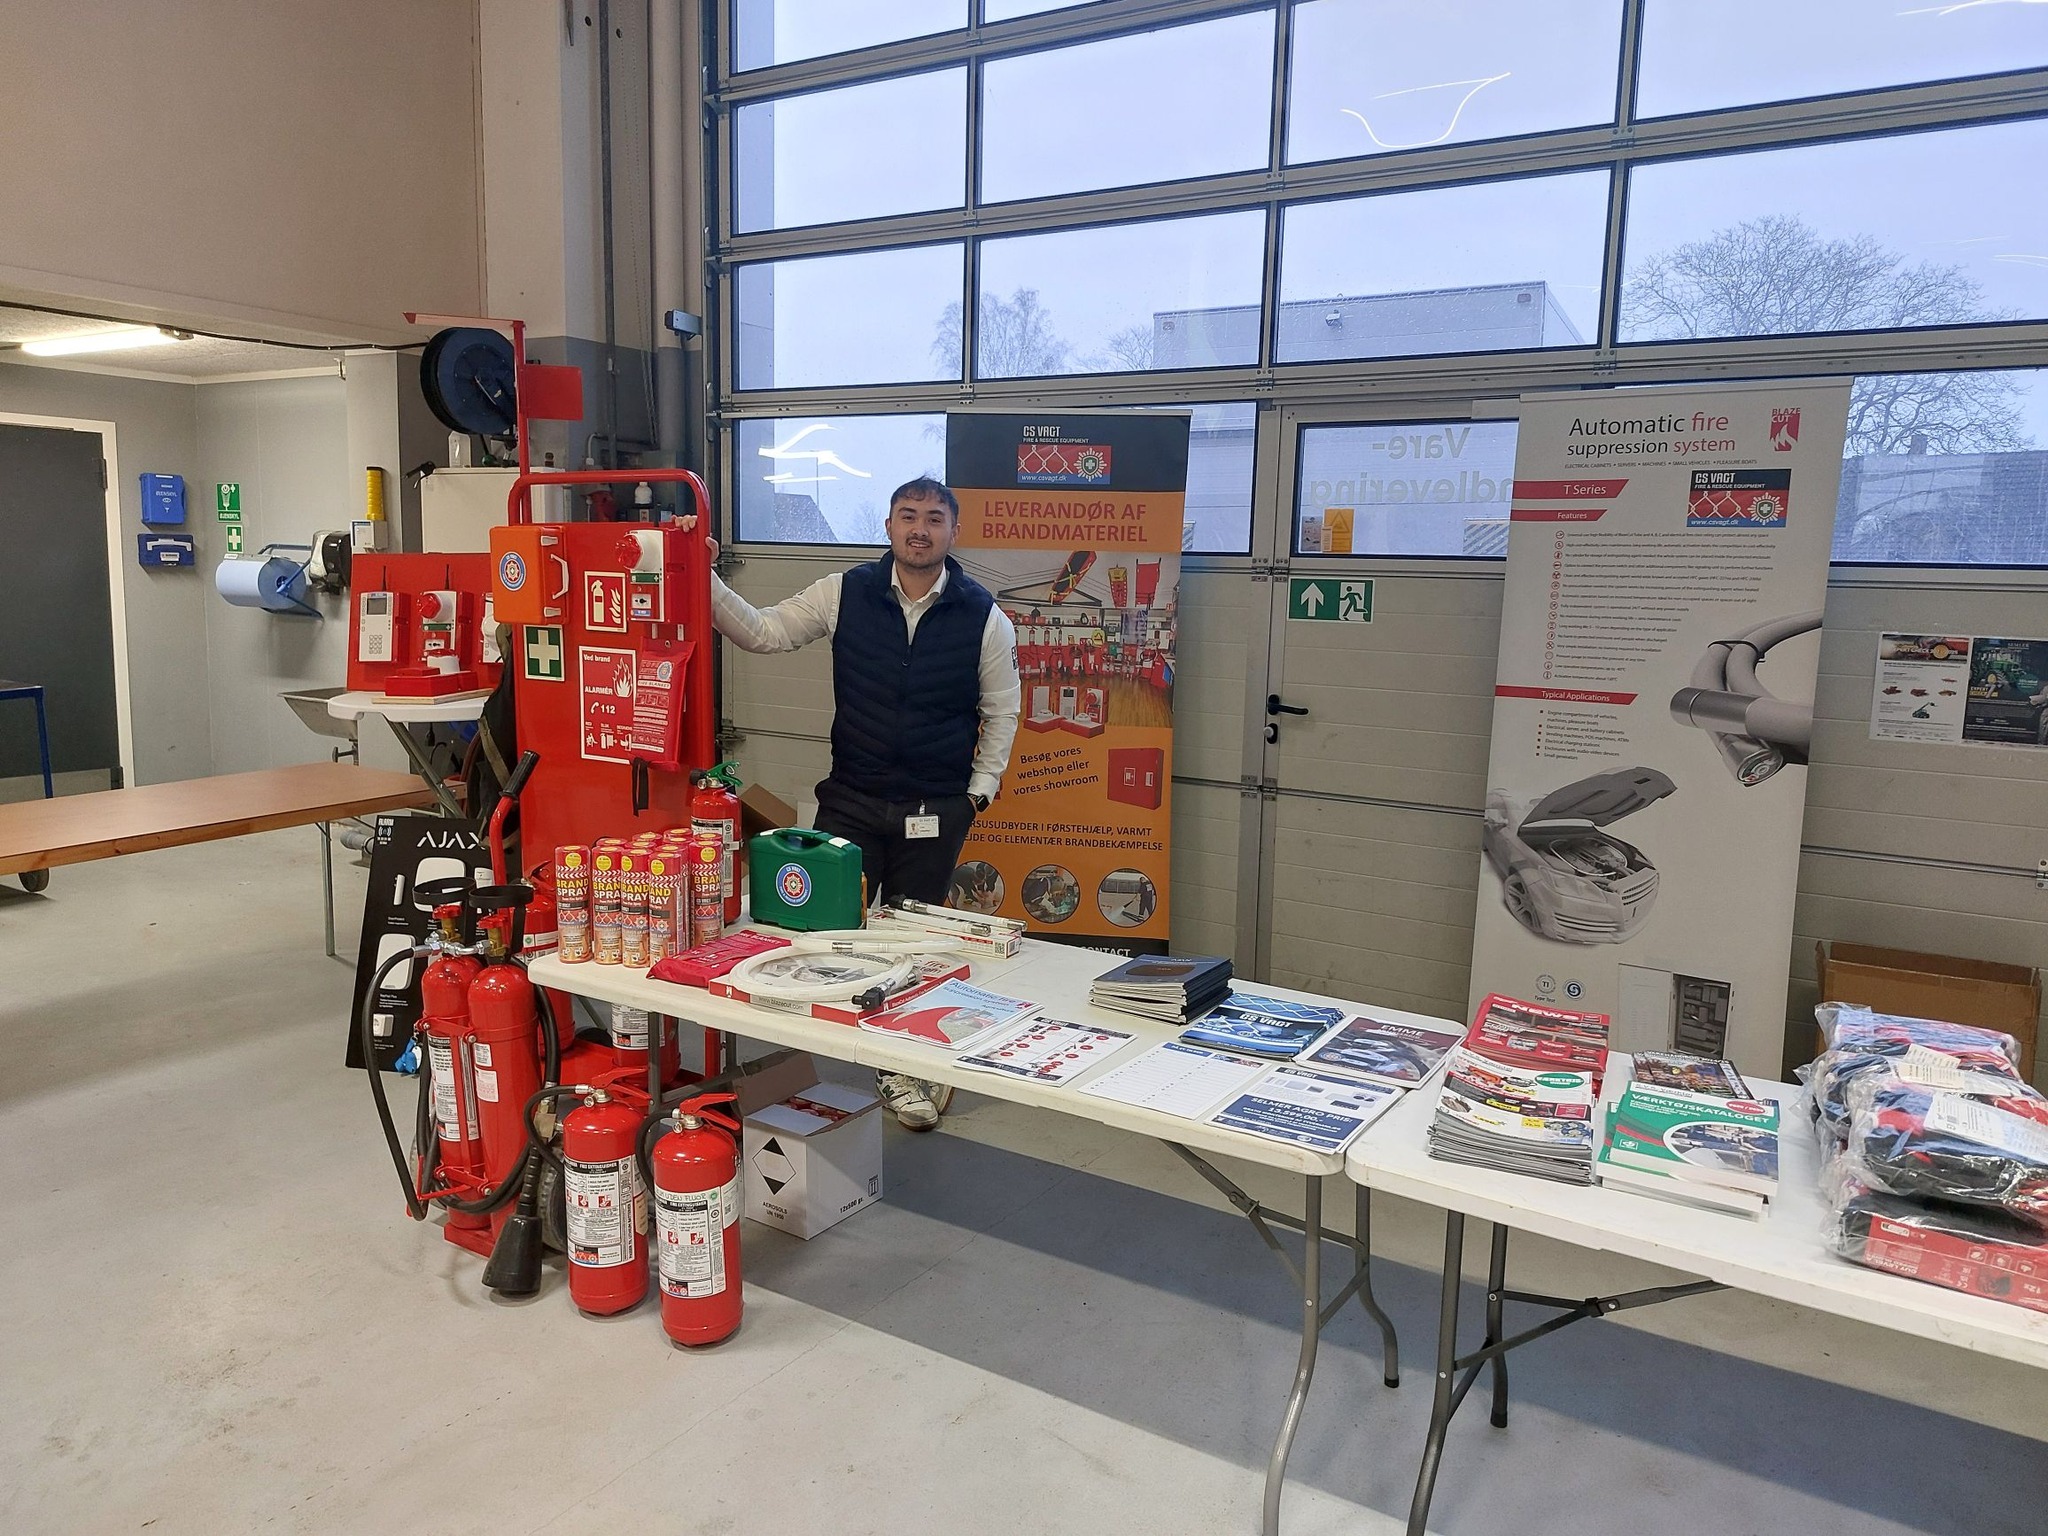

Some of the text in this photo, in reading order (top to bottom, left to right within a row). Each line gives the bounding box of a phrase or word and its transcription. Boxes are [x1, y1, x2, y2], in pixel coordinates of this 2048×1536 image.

[1772, 407, 1801, 416] BLAZE
[1568, 410, 1729, 437] Automatic fire
[1771, 415, 1790, 423] CUT
[1023, 426, 1061, 437] CS VAGT
[1567, 438, 1736, 458] suppression system
[1020, 474, 1068, 482] www.csvagt.dk
[1695, 472, 1736, 484] CS VAGT
[1564, 484, 1606, 496] T Series
[984, 500, 1146, 522] LEVERANDØR AF
[1557, 511, 1587, 520] Features
[982, 522, 1148, 542] BRANDMATERIEL
[594, 654, 611, 663] brand
[1541, 691, 1610, 702] Typical Applications
[600, 704, 616, 714] 112
[1020, 747, 1082, 764] Besøg vores
[1017, 760, 1090, 780] webshop eller
[1013, 774, 1098, 796] vores showroom
[970, 820, 1038, 832] RSUSUDBYDER
[1046, 823, 1114, 836] FØRSTEHJÆLP,
[1116, 826, 1152, 837] VARMT
[416, 830, 486, 851] AJAX
[987, 834, 1002, 843] OG
[1004, 835, 1062, 846] ELEMENTÆR
[1065, 837, 1163, 851] BRANDBEKÆMPELSE
[556, 878, 589, 888] BRAND
[694, 876, 721, 884] BRAN
[557, 886, 588, 897] SPRAY
[592, 882, 621, 891] BRAN
[650, 886, 671, 896] AND
[695, 884, 721, 892] SPRA
[594, 890, 621, 899] SPRA
[622, 892, 648, 902] PRAY
[650, 895, 670, 905] RAY
[1082, 946, 1131, 957] ONTACT
[924, 959, 950, 969] fire
[950, 982, 994, 1000] Automatic
[1534, 994, 1545, 1003] Type
[1238, 1013, 1294, 1028] CS VAGT
[1250, 1097, 1292, 1110] SELMER
[1292, 1105, 1326, 1118] AGRO
[1631, 1094, 1770, 1124] VÆRKTØJSKATALOGET
[763, 1201, 788, 1215] AEROSOLS
